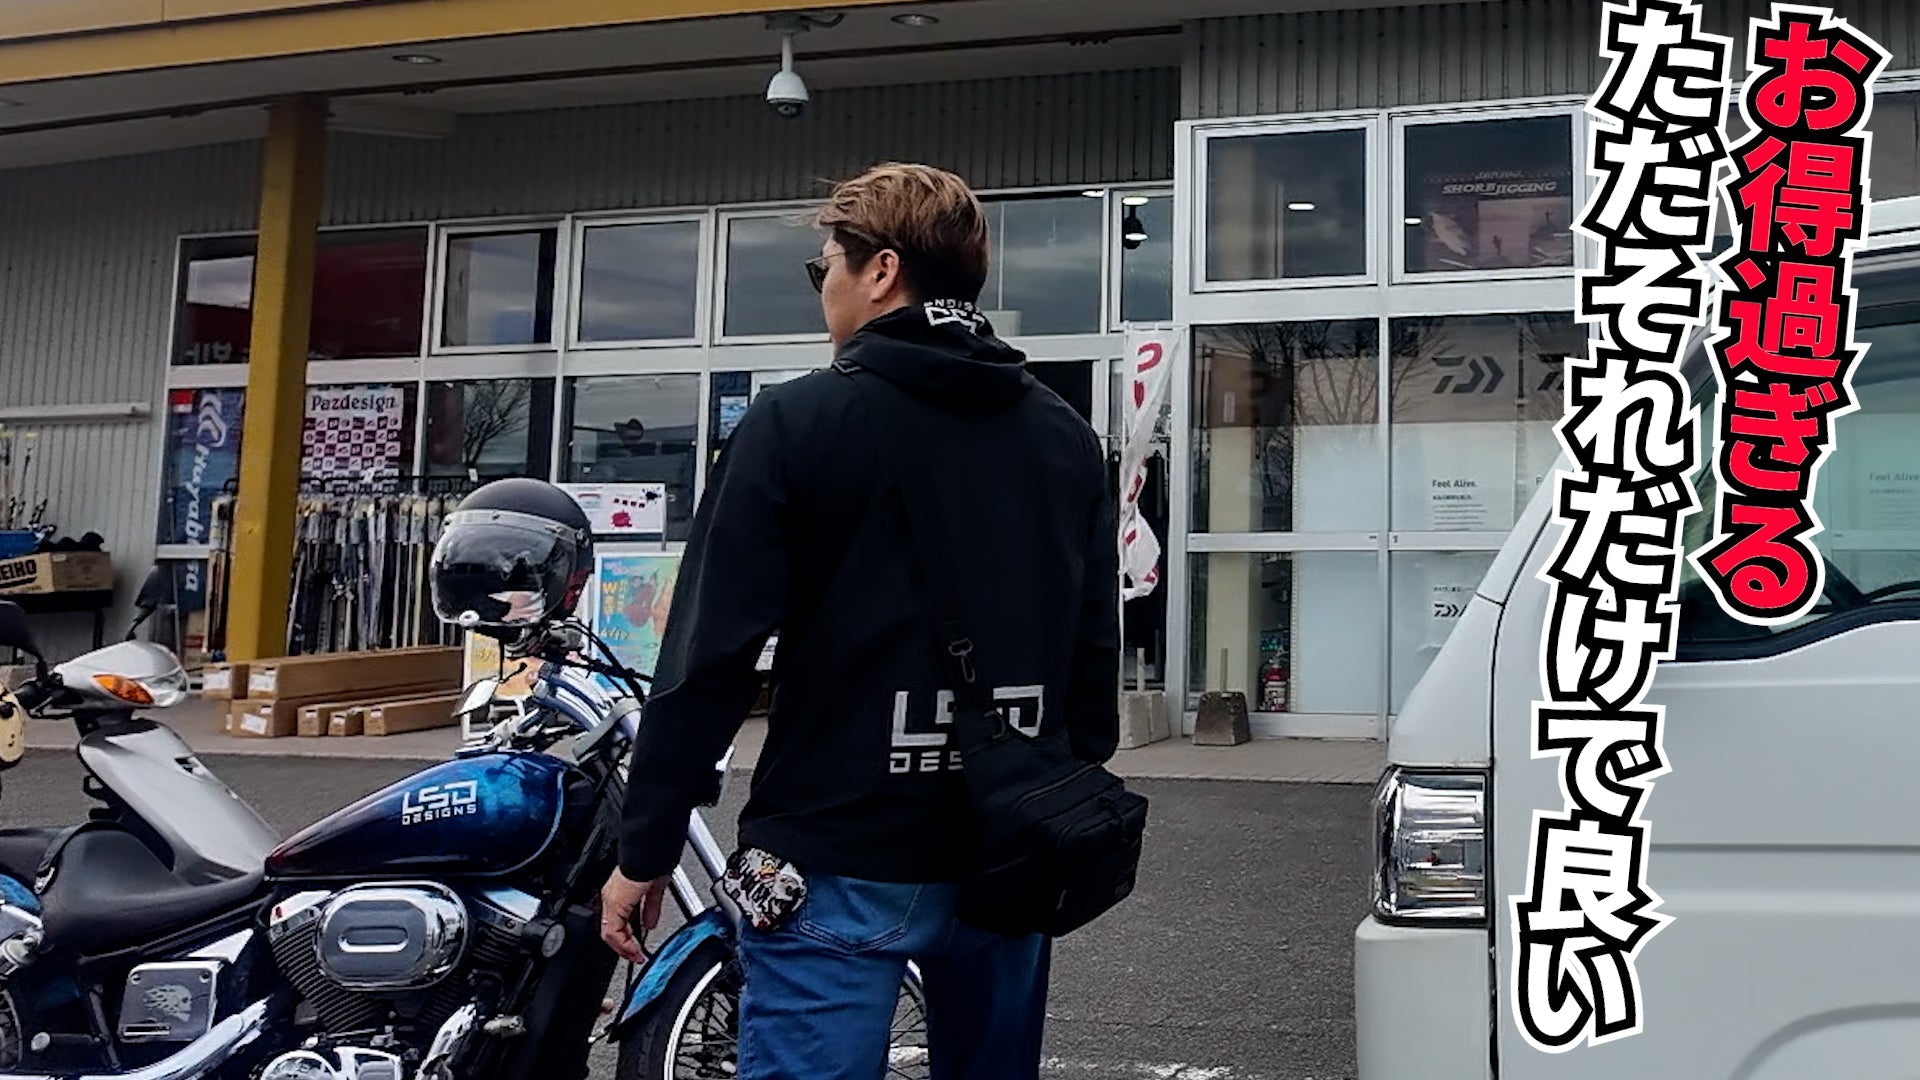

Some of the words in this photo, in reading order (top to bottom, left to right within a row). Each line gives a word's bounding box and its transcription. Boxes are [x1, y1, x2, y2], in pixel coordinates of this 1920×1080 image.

[311, 394, 396, 412] Pazdesign
[1432, 479, 1451, 488] Feel
[0, 560, 37, 580] EIHO
[889, 751, 964, 773] DES
[402, 780, 478, 815] LSD
[402, 804, 477, 825] DESIGNS
